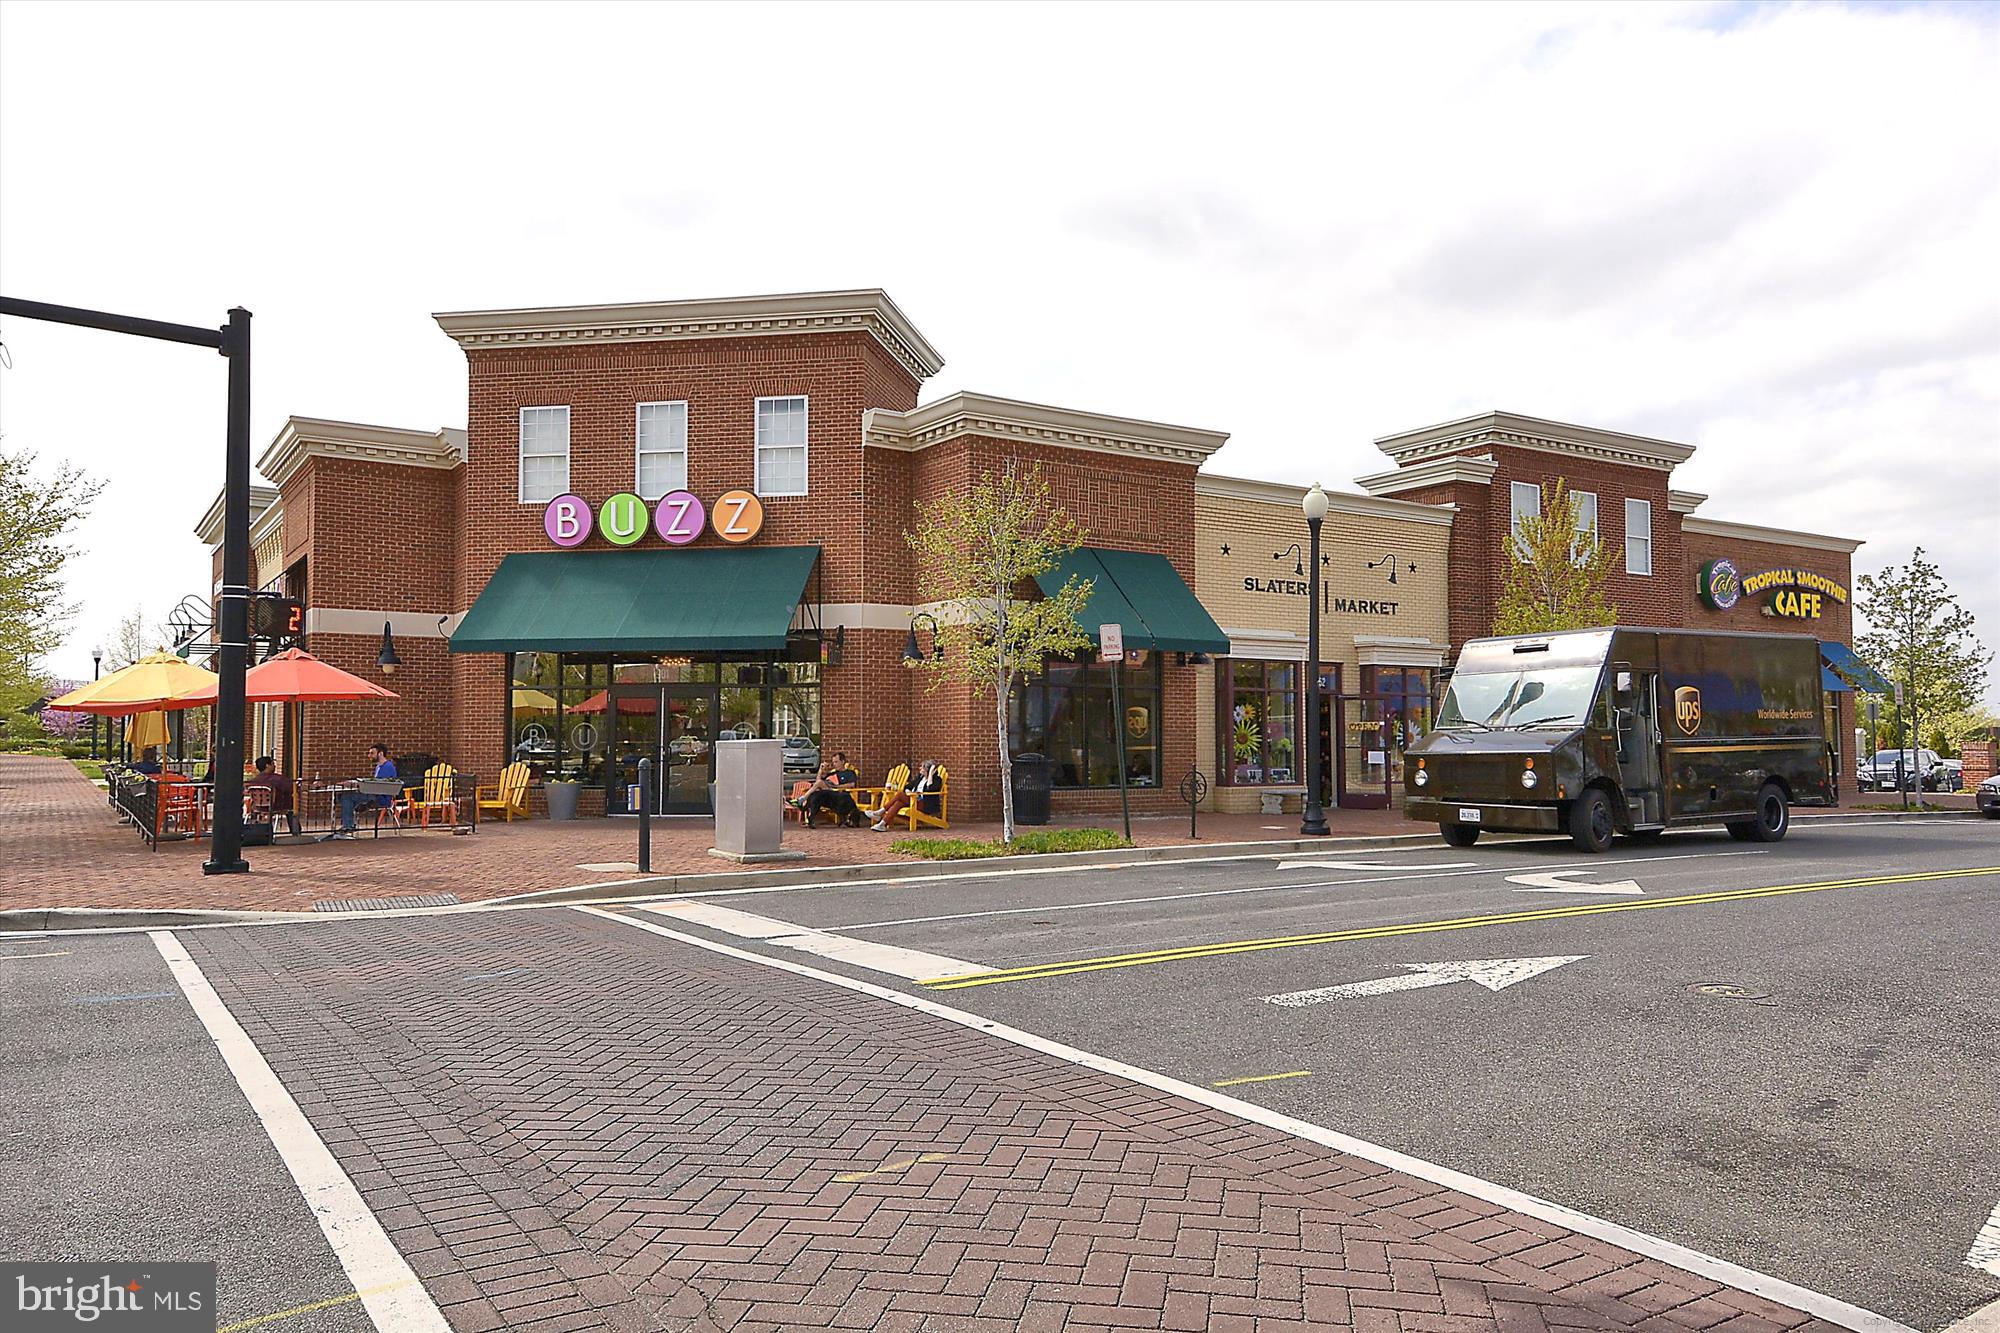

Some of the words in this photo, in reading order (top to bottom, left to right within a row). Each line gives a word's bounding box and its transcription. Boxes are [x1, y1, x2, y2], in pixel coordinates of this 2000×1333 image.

[556, 498, 749, 538] BUZZ
[1244, 577, 1311, 595] SLATER
[1743, 569, 1795, 594] TROPICAL
[1796, 571, 1848, 602] SMOOTHIE
[1335, 598, 1398, 615] MARKET
[1775, 590, 1821, 618] CAFE
[289, 607, 301, 631] 2
[1677, 701, 1699, 727] ups
[1757, 709, 1789, 719] Worldwide
[1790, 708, 1814, 719] Services
